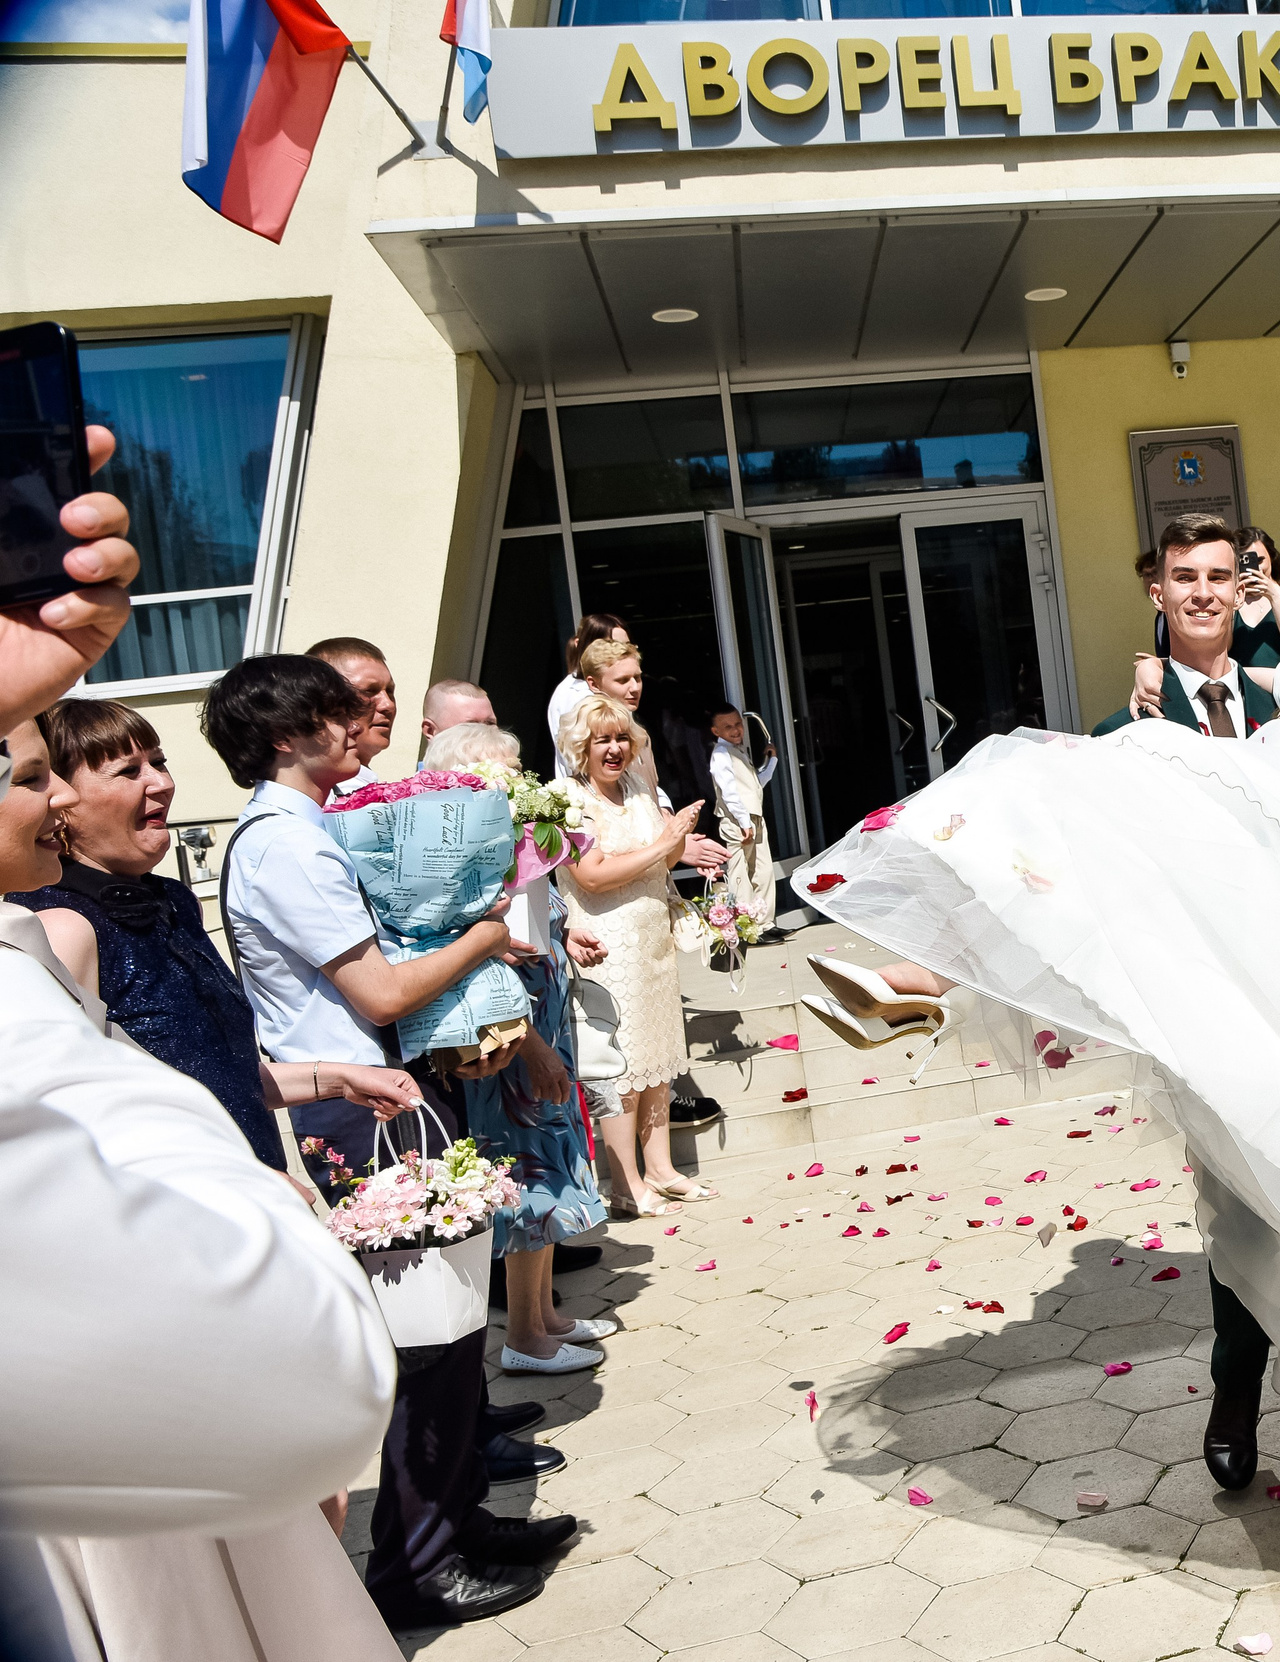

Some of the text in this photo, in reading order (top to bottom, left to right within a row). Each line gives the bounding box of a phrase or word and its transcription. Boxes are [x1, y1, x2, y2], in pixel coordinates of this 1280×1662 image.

[593, 34, 1021, 132] ДВОРЕЦ
[367, 810, 385, 826] Good
[441, 804, 454, 846] Good Luck
[390, 904, 412, 913] Luck
